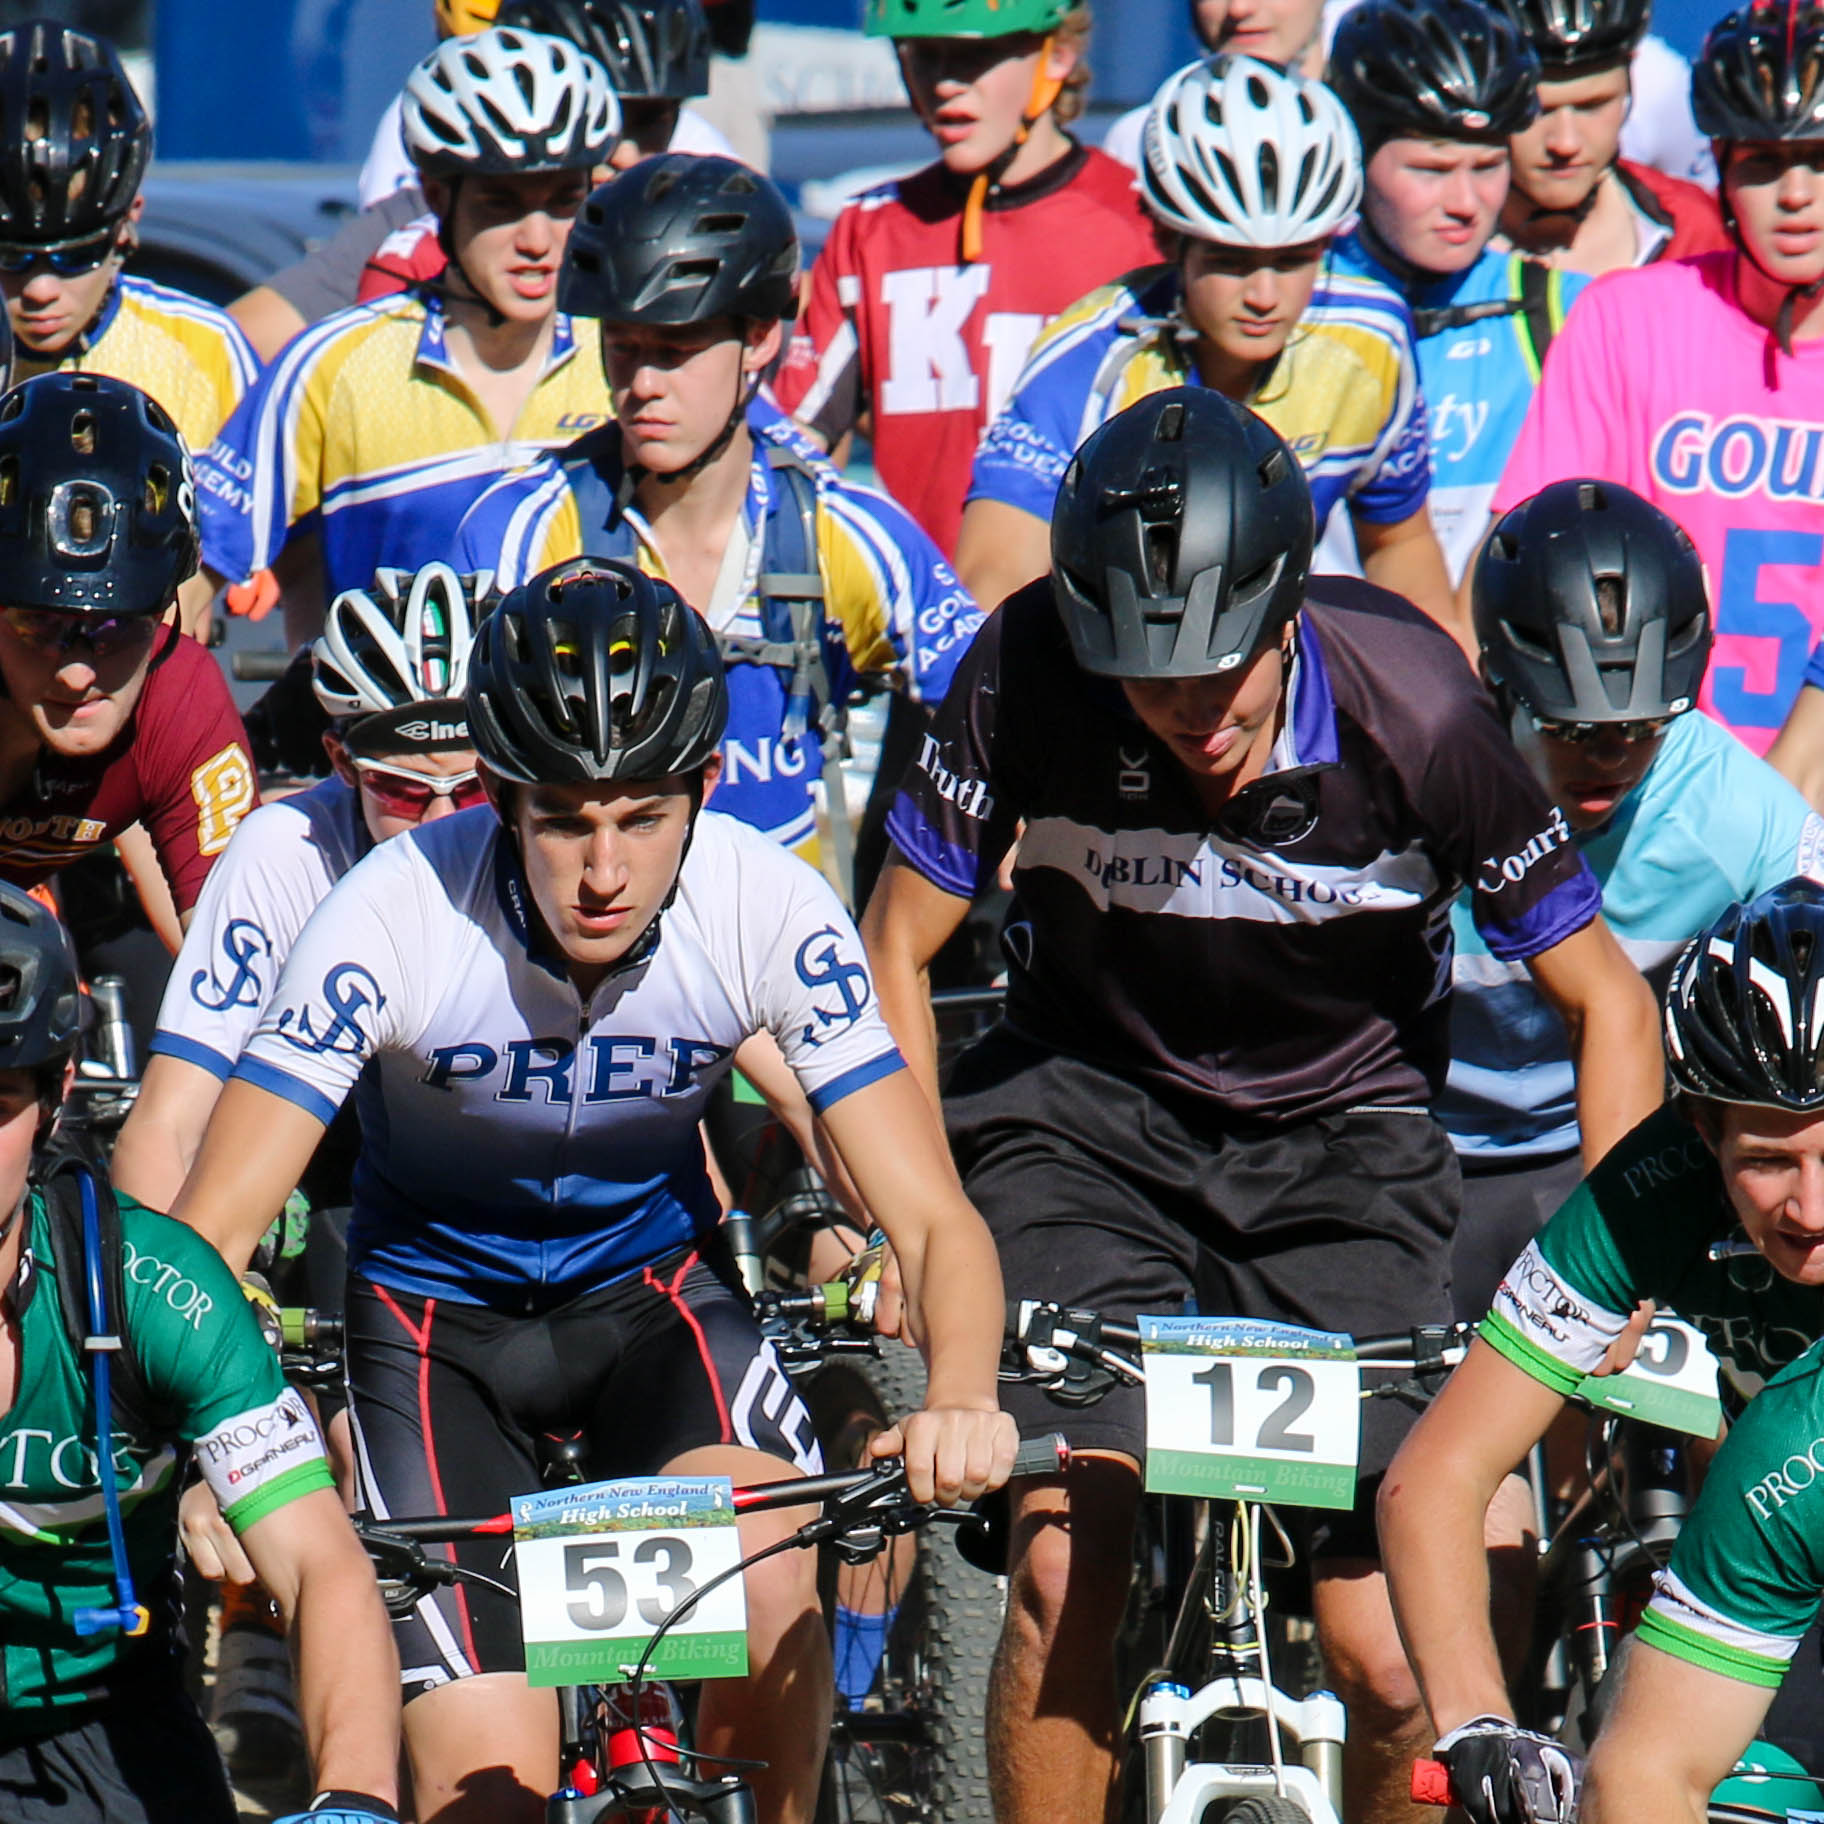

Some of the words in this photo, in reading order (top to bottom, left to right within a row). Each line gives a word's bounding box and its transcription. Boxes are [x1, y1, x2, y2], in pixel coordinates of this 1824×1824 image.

[418, 1034, 738, 1108] PREP
[1186, 1333, 1236, 1351] High
[1242, 1334, 1311, 1352] School
[1190, 1361, 1318, 1454] 12
[534, 1488, 605, 1510] Northern
[642, 1483, 712, 1500] England
[560, 1502, 618, 1526] High
[622, 1500, 689, 1521] School
[562, 1538, 700, 1632] 53
